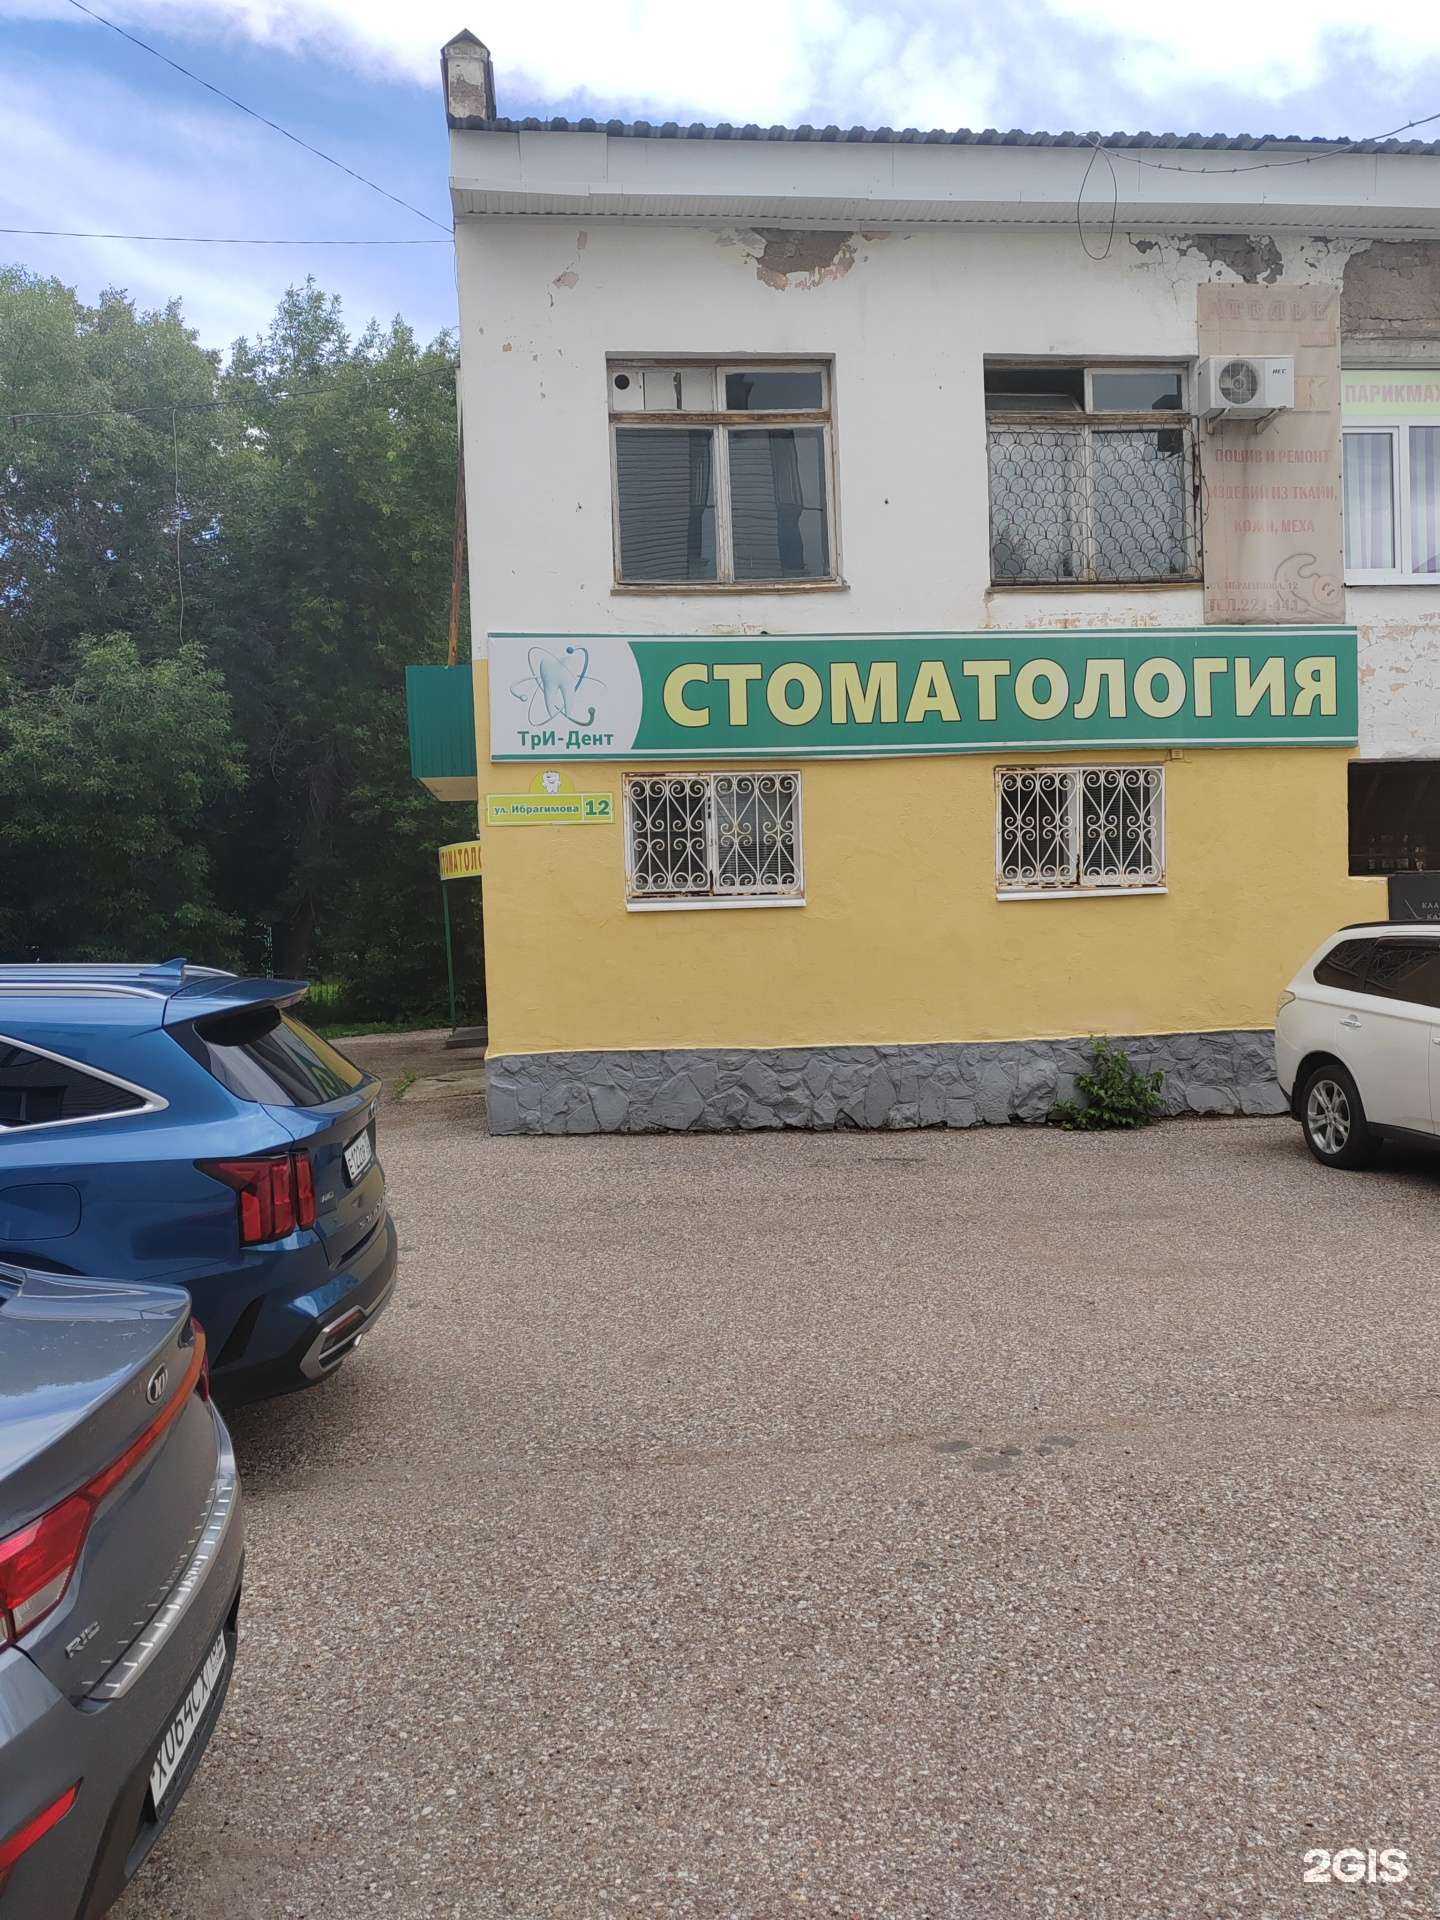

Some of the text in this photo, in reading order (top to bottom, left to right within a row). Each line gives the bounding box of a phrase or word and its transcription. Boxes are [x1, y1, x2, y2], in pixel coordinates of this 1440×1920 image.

[662, 656, 1337, 728] СТОМАТОЛОГИЯ
[517, 730, 614, 750] ТрИ-Дент
[494, 799, 610, 816] ул. Ибрагимова 12
[65, 1621, 101, 1659] RIO
